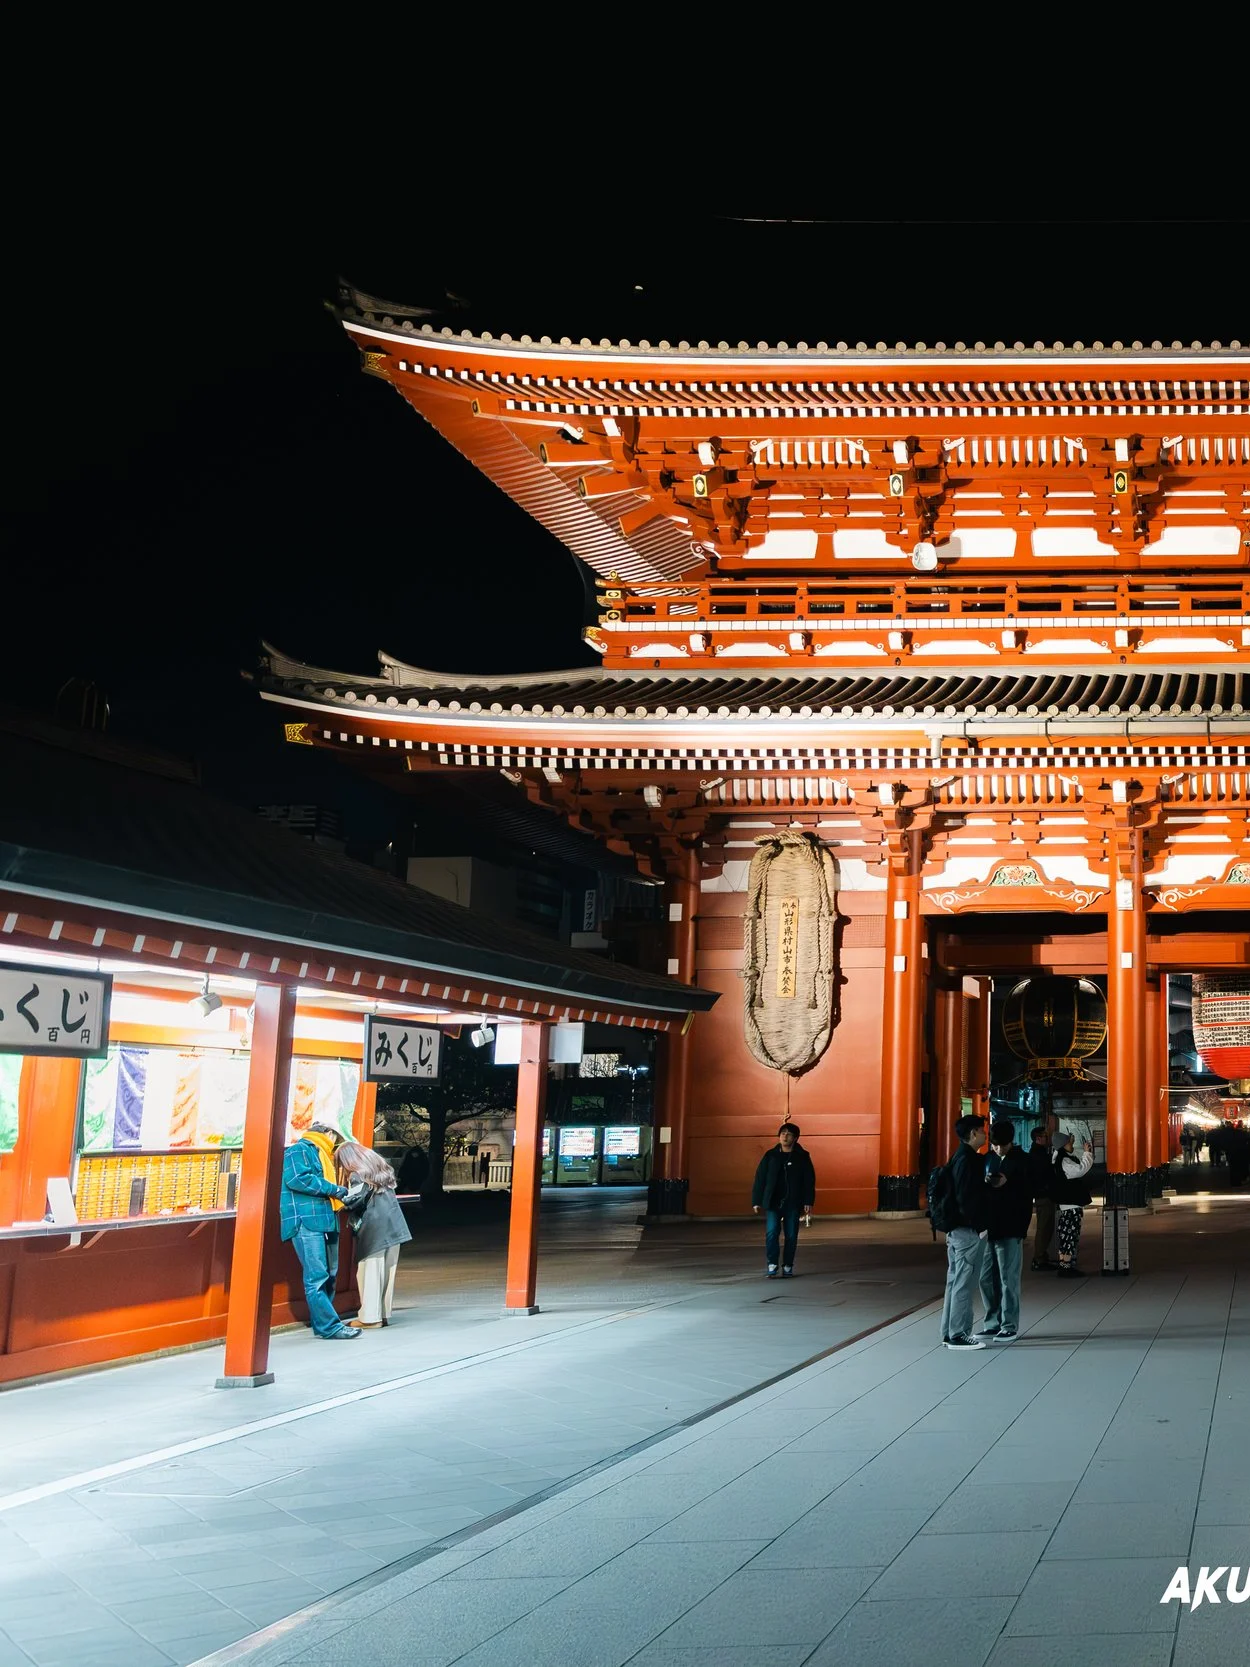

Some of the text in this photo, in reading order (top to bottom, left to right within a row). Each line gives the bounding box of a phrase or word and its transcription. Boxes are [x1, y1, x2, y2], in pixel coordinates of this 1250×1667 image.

[0, 983, 89, 1034] くじ
[47, 1027, 91, 1044] 百円
[375, 1031, 433, 1069] みくじ
